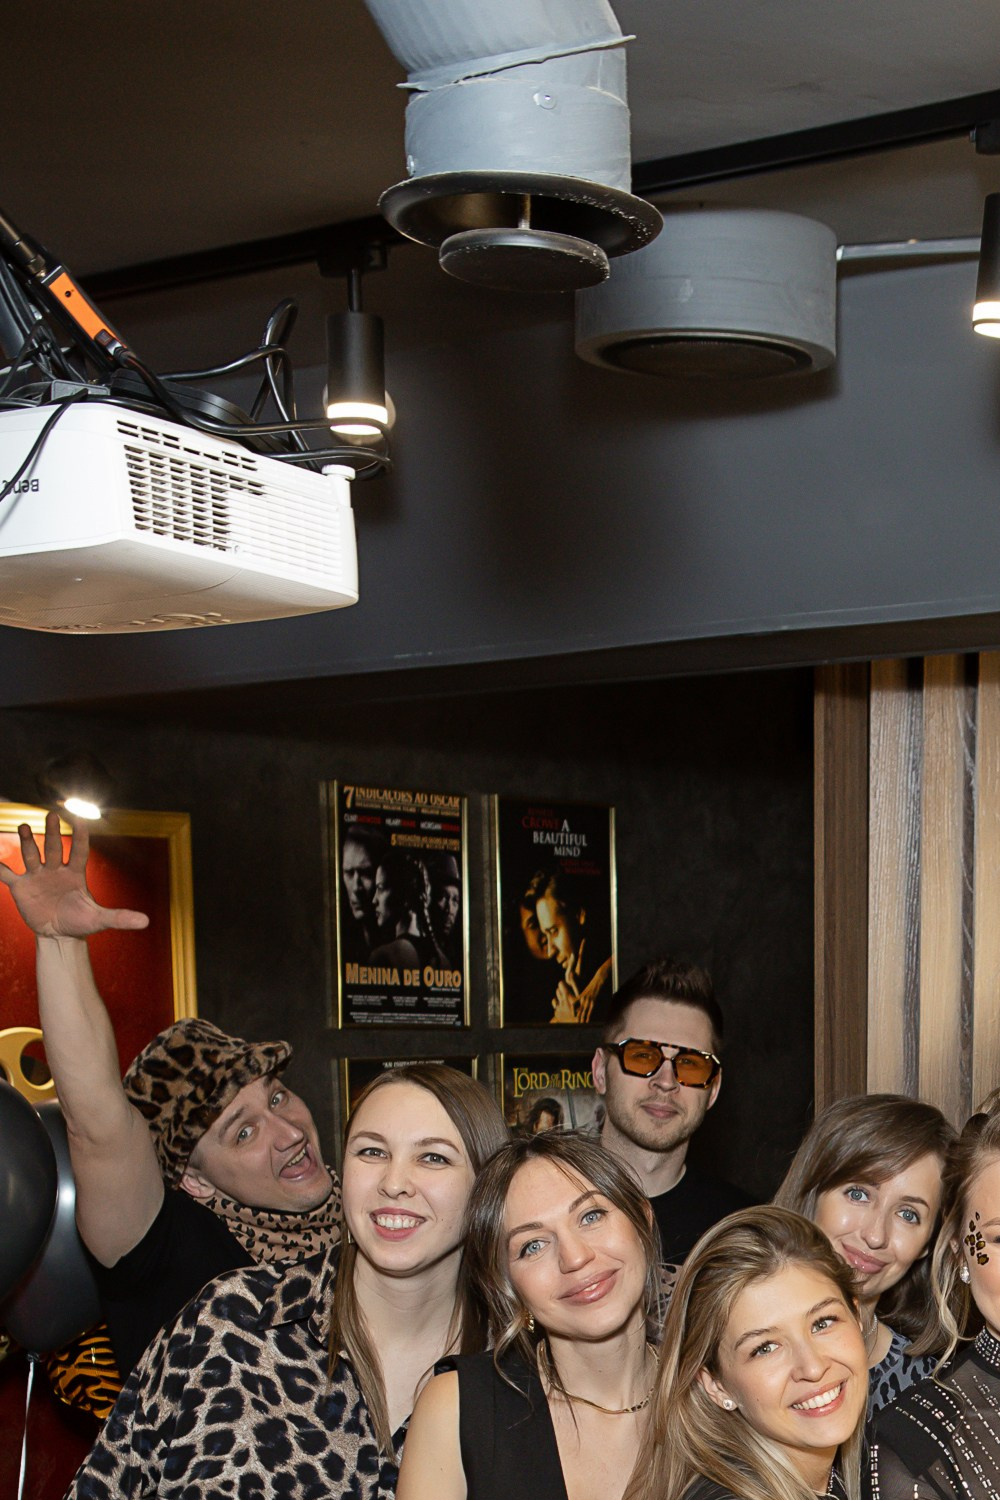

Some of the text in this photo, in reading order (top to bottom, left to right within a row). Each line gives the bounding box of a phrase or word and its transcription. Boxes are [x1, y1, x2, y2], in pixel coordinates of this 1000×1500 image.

[343, 785, 355, 809] 7
[561, 818, 571, 832] A
[532, 830, 588, 848] BEAUTIFUL
[553, 845, 581, 858] MIND
[345, 962, 462, 988] MENINA DE OURO
[513, 1067, 550, 1097] LORD
[560, 1068, 593, 1090] RING
